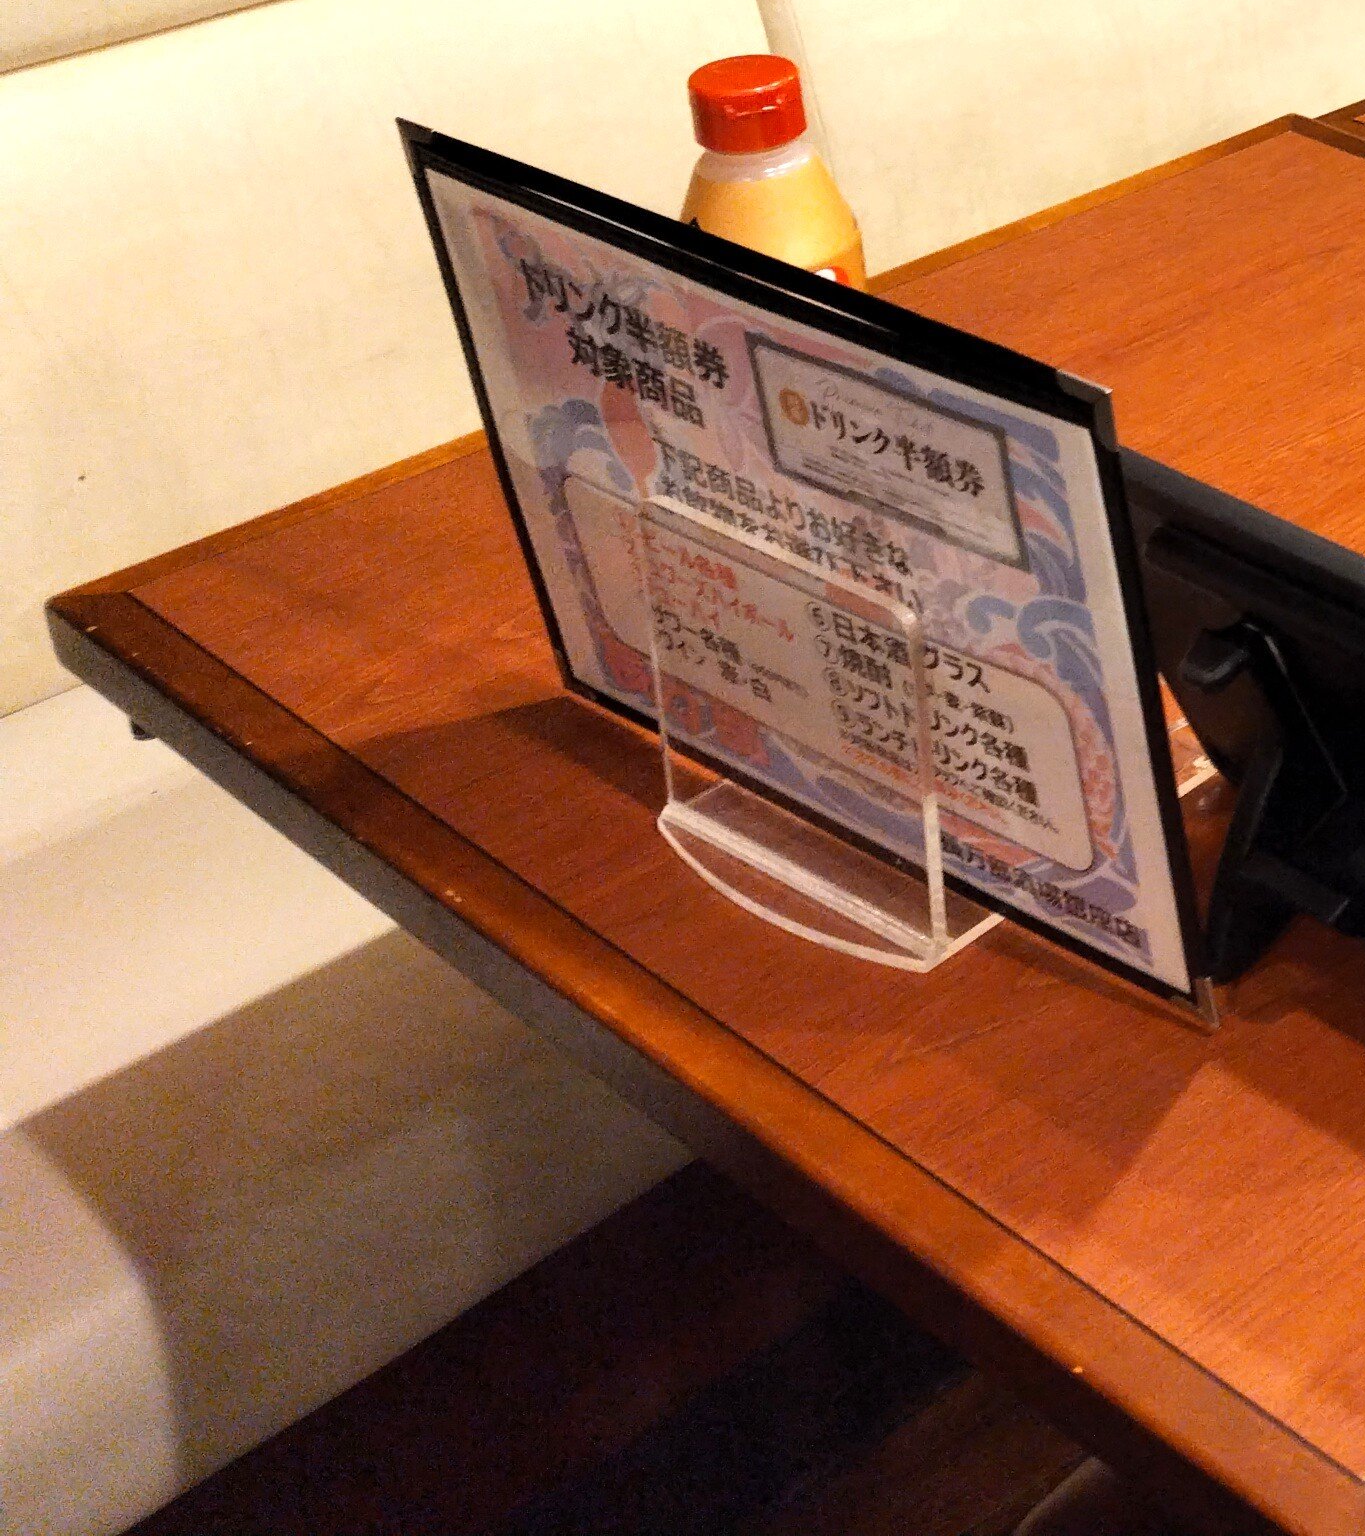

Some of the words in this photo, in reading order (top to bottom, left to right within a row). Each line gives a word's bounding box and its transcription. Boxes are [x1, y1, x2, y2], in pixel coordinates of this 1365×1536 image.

[520, 258, 730, 390] ドリンク半額券
[565, 325, 706, 430] 対象商品
[811, 400, 986, 498] ドリンク半額券
